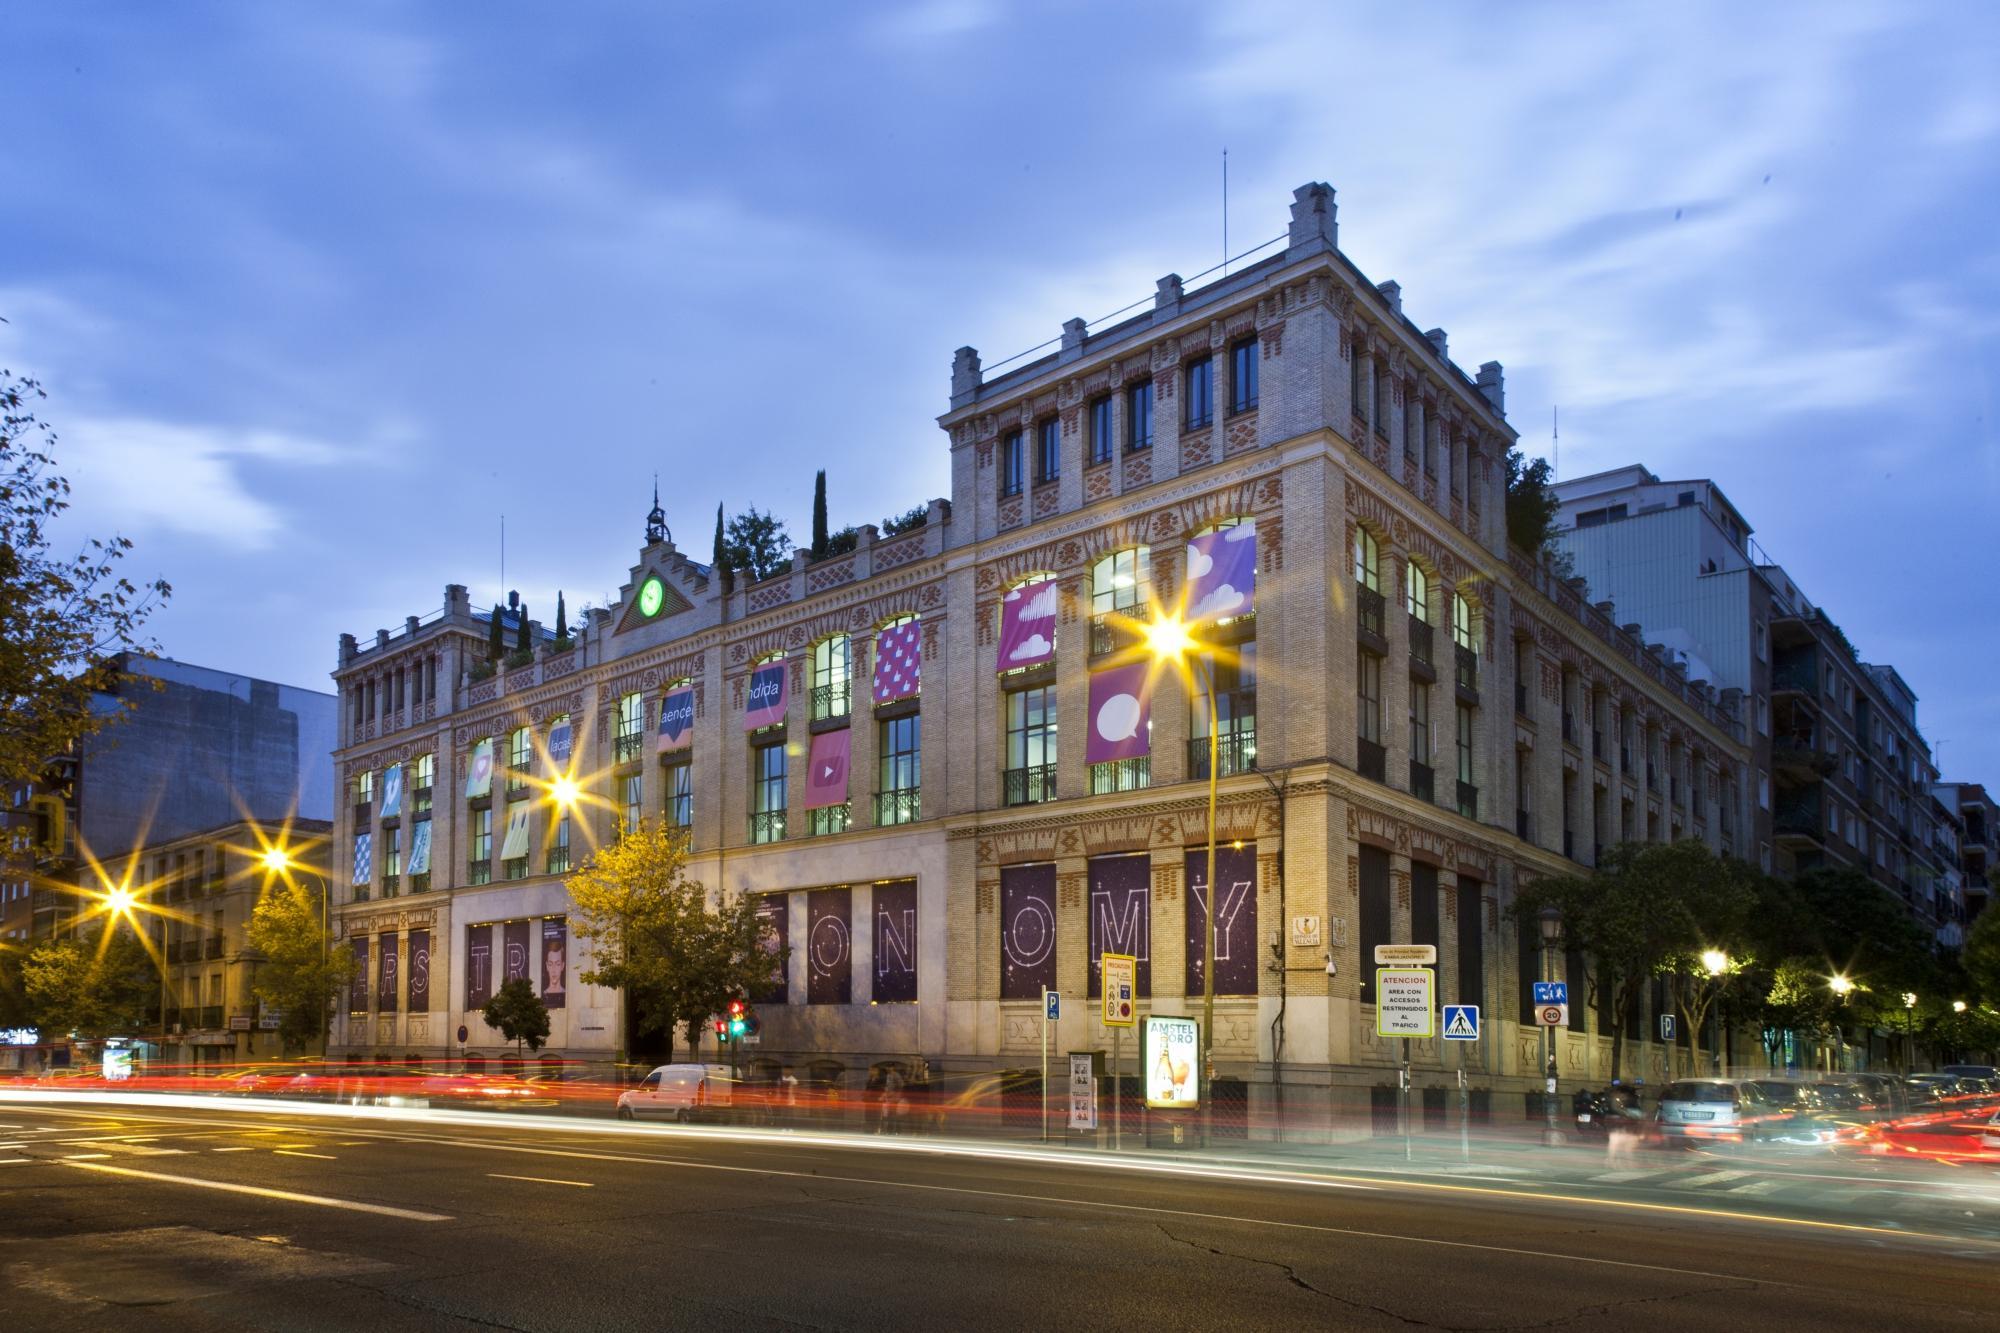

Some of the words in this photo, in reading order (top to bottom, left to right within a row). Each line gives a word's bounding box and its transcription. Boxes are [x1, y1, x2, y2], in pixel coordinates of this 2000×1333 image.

[660, 706, 693, 723] aence
[1050, 996, 1057, 1009] P
[1150, 1022, 1194, 1035] AMSTEL
[1665, 1017, 1672, 1037] P
[1168, 1034, 1193, 1044] ORO
